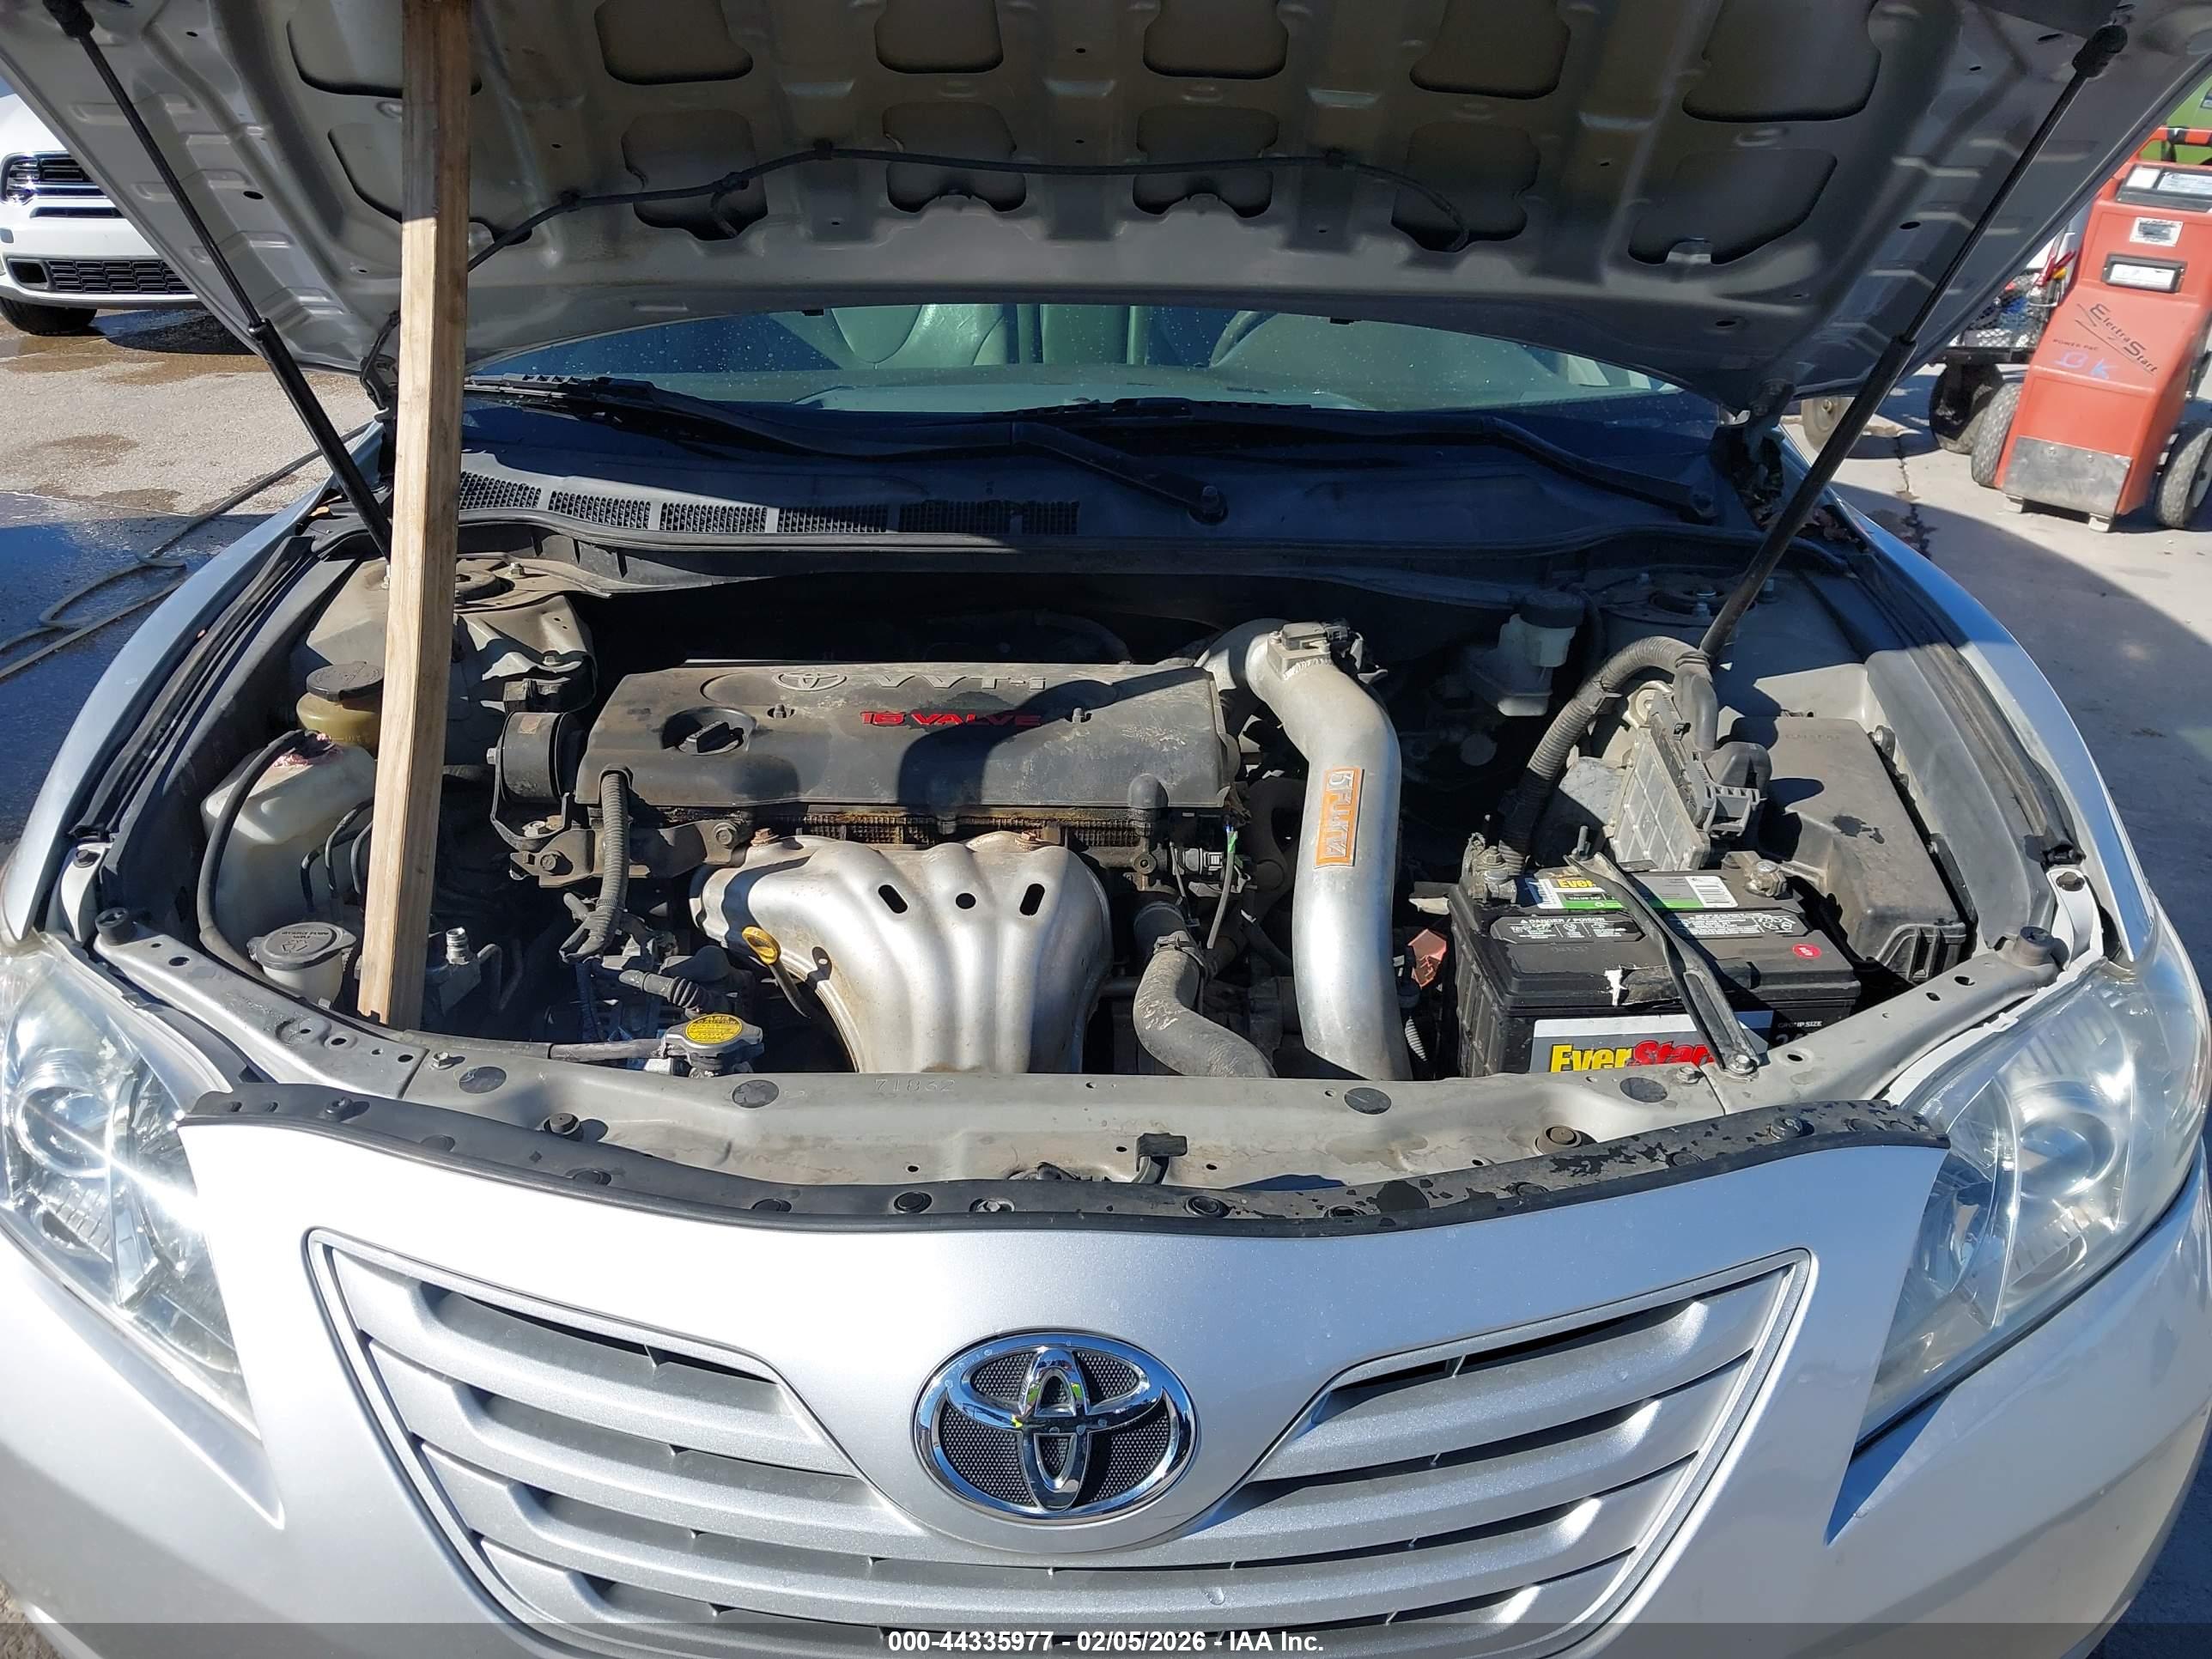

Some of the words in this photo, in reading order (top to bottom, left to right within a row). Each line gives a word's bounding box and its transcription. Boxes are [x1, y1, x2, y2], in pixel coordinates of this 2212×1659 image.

[860, 710, 906, 726] 16
[910, 713, 1042, 726] VALVE
[1557, 879, 1596, 888] Ever
[1550, 1040, 1715, 1073] EverStar
